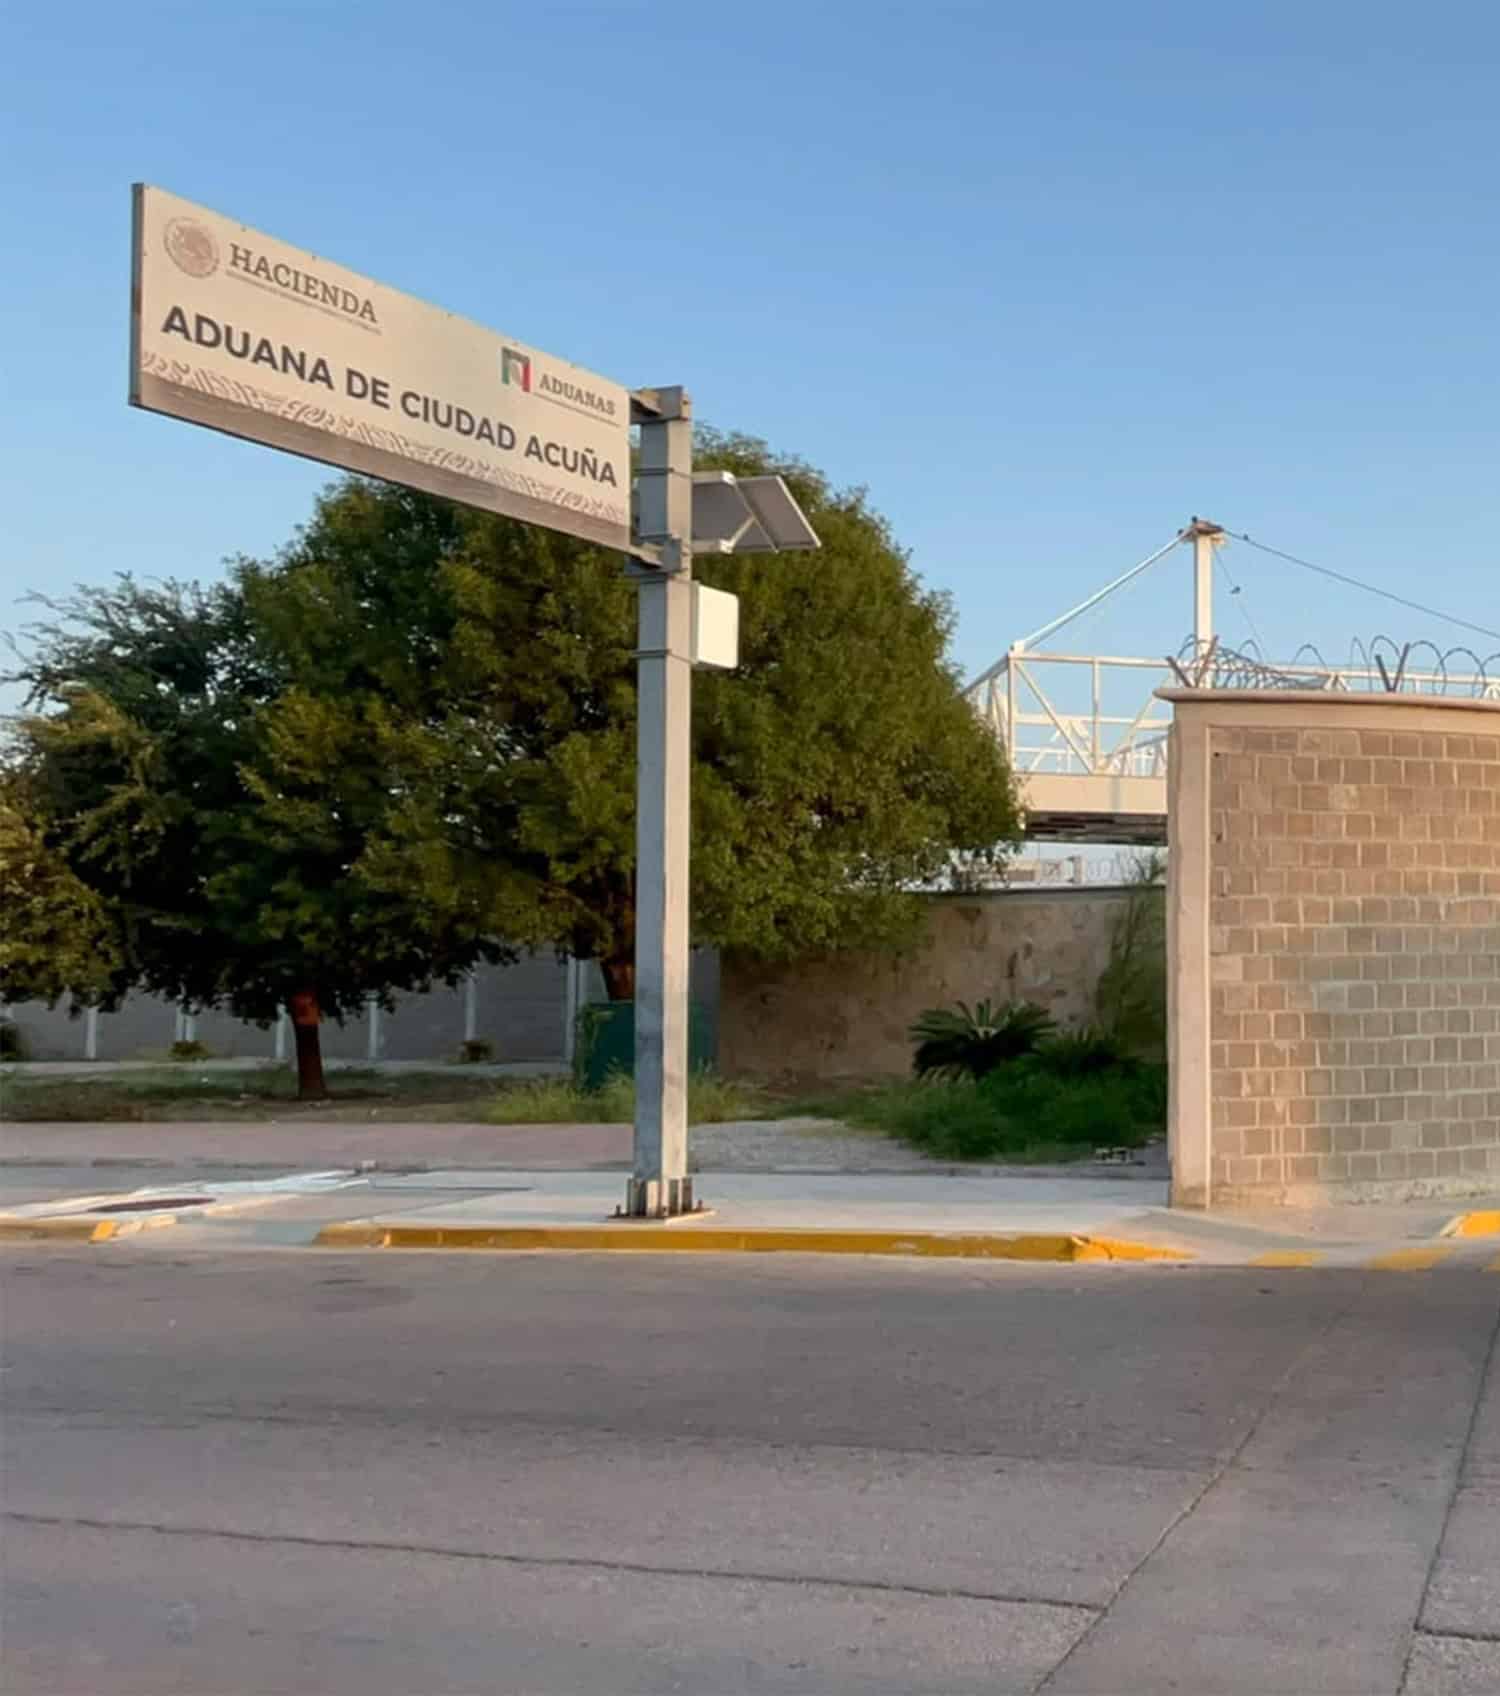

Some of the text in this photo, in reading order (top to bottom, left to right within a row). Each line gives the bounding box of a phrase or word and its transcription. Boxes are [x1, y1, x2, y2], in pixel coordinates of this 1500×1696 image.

[229, 243, 378, 323] HACIENDA
[162, 306, 617, 488] ADUANA DE CIUDAD ACUÑA
[539, 374, 616, 415] ADUANAS
